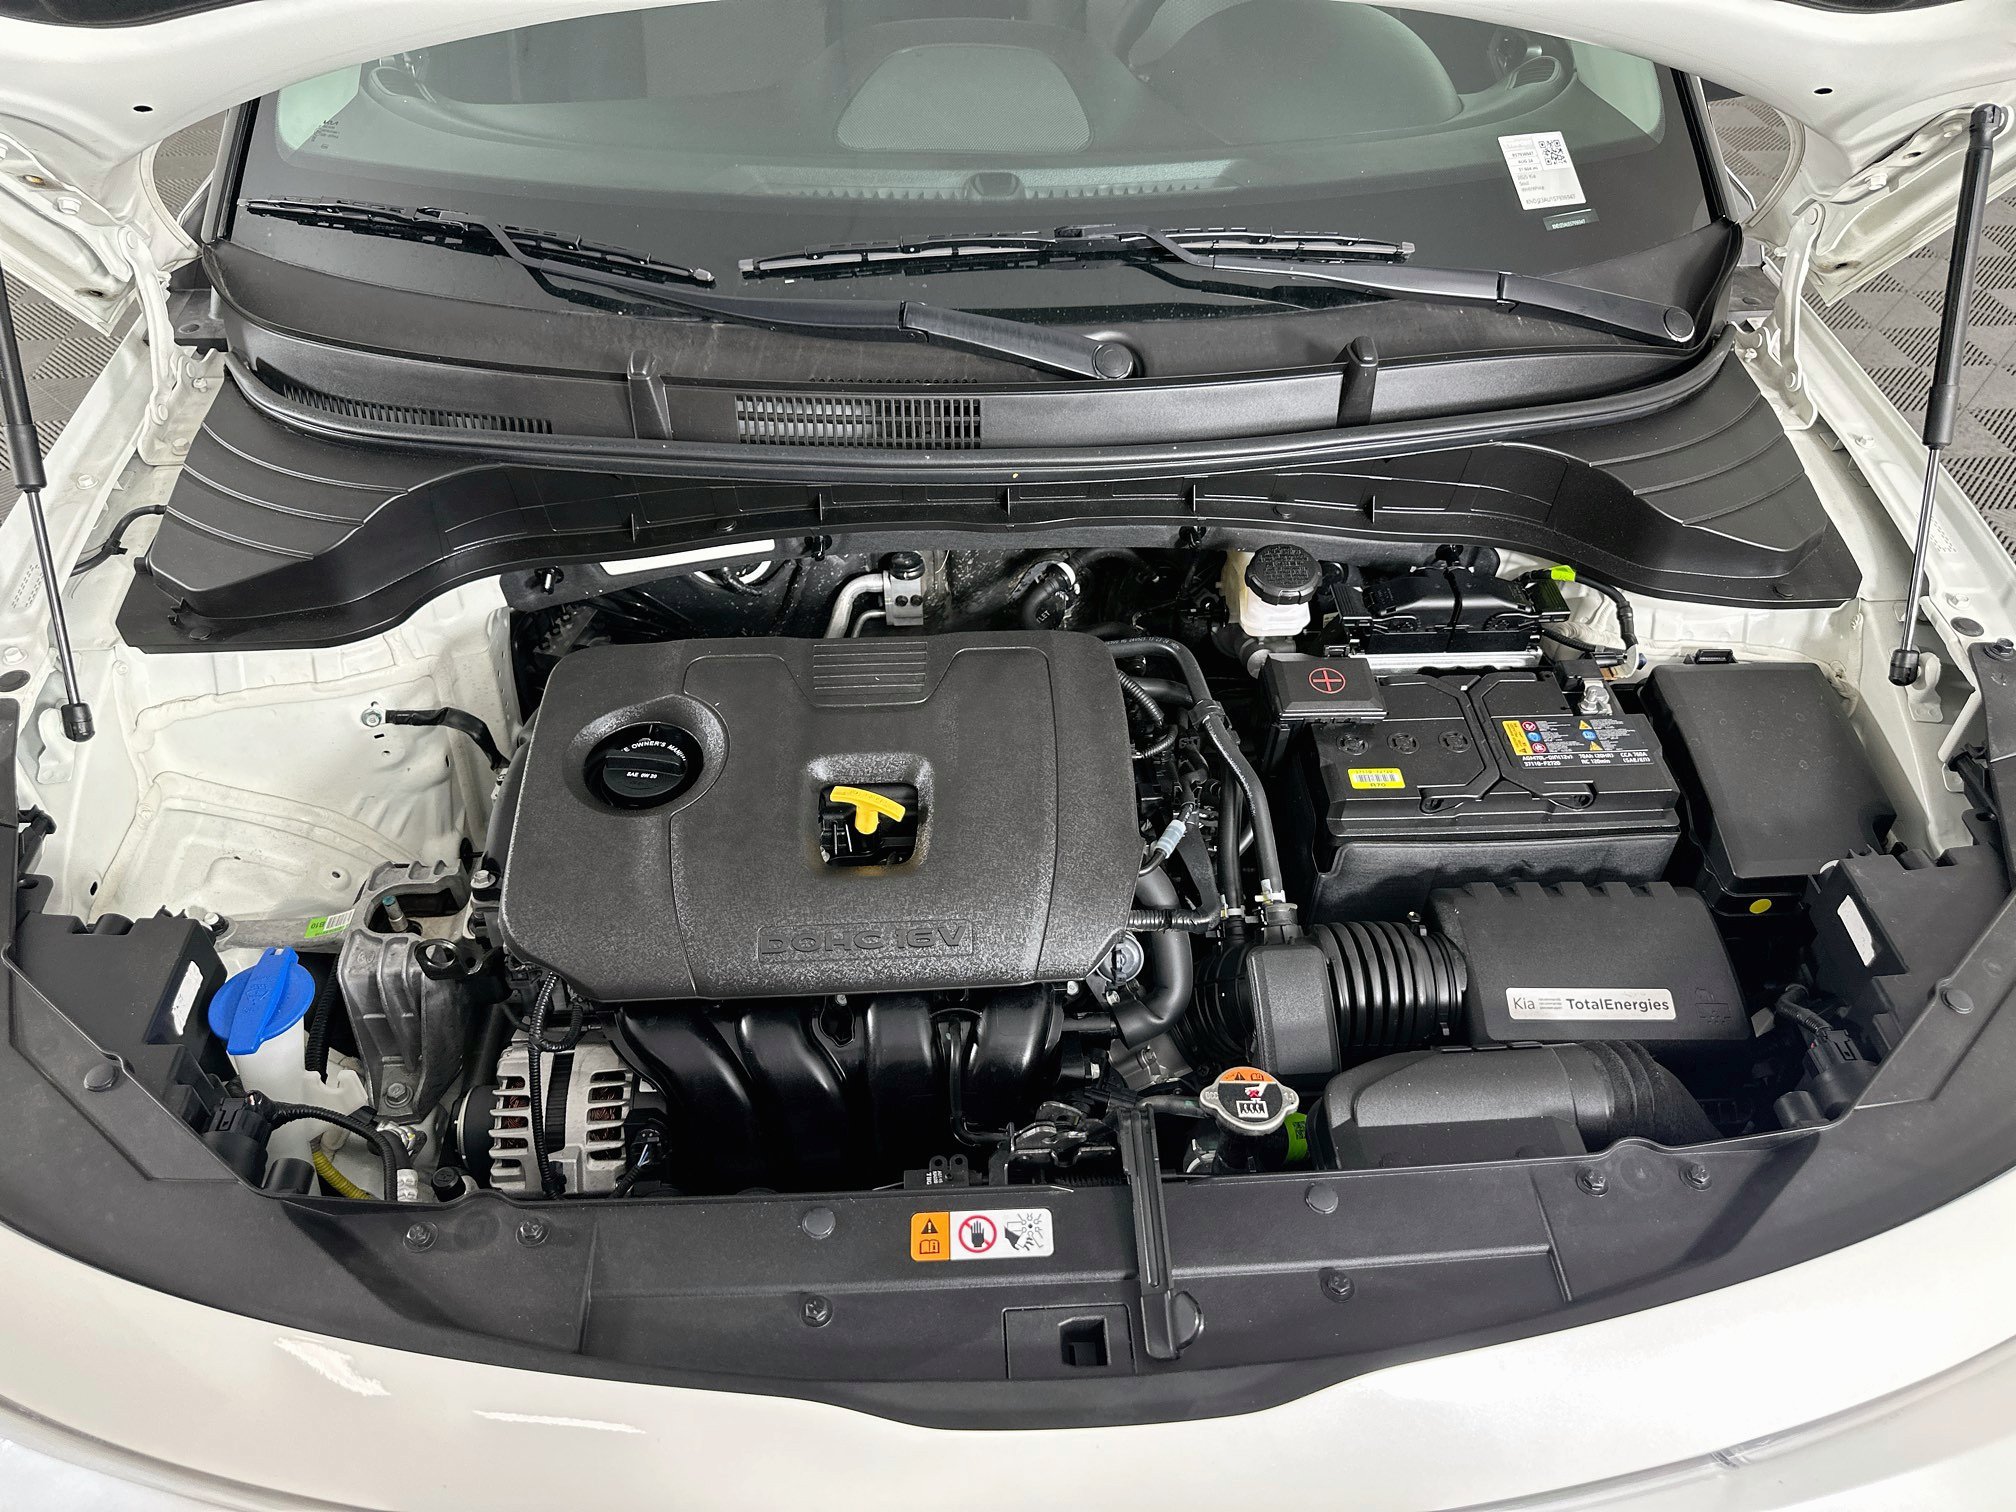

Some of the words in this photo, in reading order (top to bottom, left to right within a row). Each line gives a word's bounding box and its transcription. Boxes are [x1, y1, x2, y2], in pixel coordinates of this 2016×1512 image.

[631, 740, 667, 749] OWNER'S
[761, 930, 885, 955] DOHC
[895, 925, 966, 950] 16V
[1513, 997, 1536, 1010] Kia
[1566, 997, 1670, 1013] TotalEnergies
